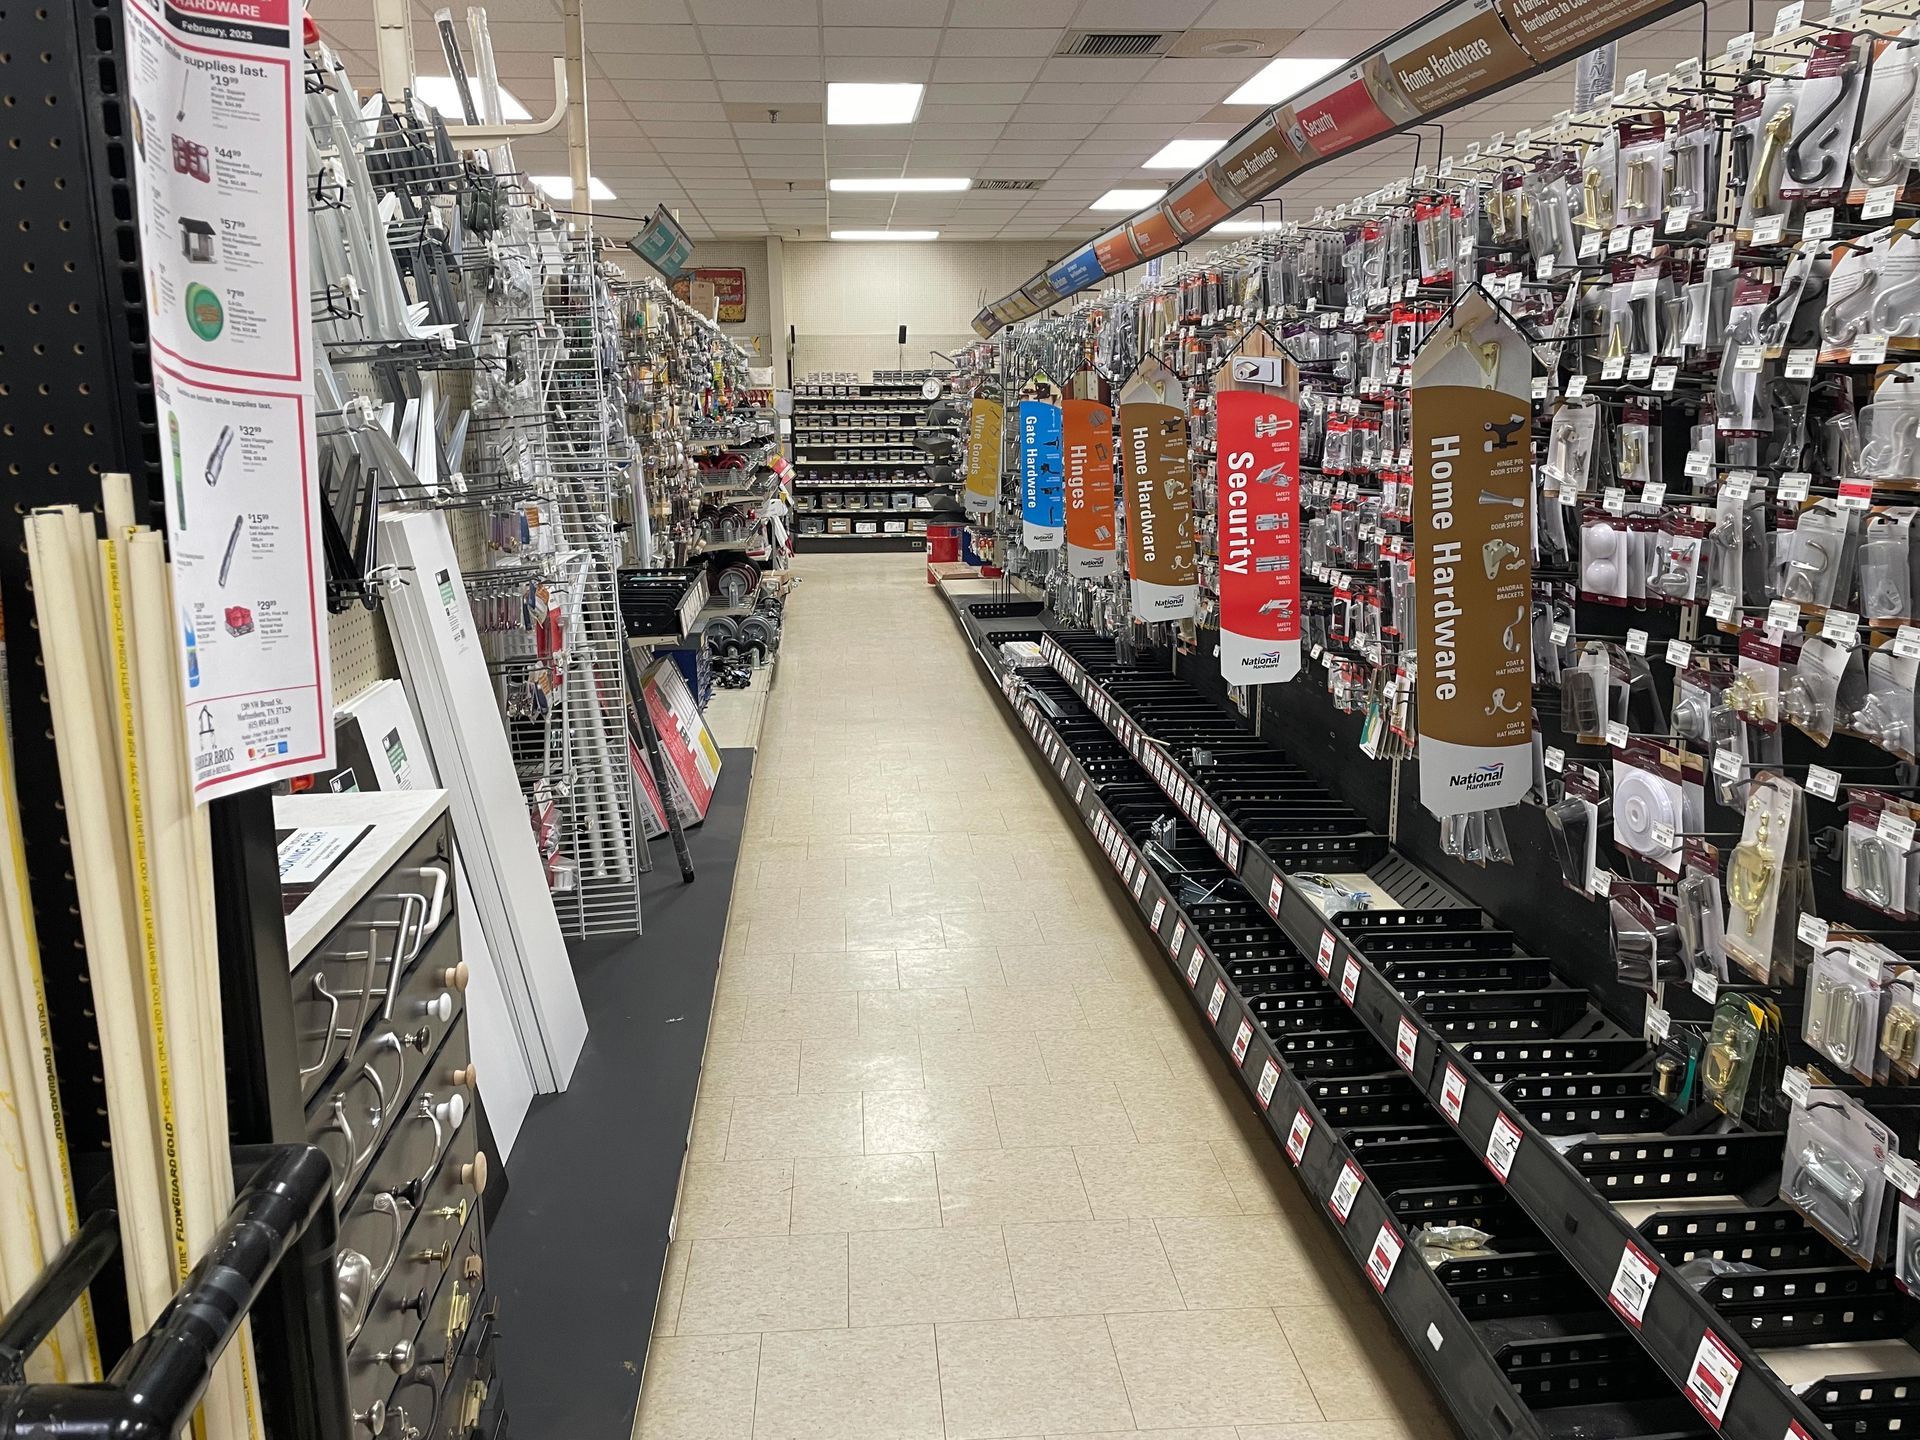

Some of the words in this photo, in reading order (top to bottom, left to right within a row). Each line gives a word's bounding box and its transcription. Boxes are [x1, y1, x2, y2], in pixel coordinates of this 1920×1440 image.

[1521, 7, 1562, 33] Hardware
[1561, 4, 1571, 15] to
[182, 20, 228, 38] February,
[229, 29, 254, 40] 2025
[184, 57, 236, 74] supplies
[240, 64, 268, 78] last.
[1399, 64, 1434, 92] Home
[1430, 36, 1492, 78] Hardware
[1303, 111, 1338, 138] Security
[1227, 168, 1249, 186] Home
[1243, 145, 1279, 175] Hardware
[232, 399, 257, 409] supplies
[258, 401, 272, 410] last.
[975, 413, 986, 440] Wire
[1025, 416, 1037, 445] Gate
[970, 443, 983, 475] Goods
[1132, 427, 1149, 475] Home
[1027, 448, 1038, 509] Hardware
[1068, 445, 1087, 510] Hinges
[1490, 468, 1505, 476] DOOR
[1507, 466, 1524, 475] STOPS
[1431, 435, 1461, 530] Home
[1137, 481, 1156, 562] Hardware
[1223, 451, 1255, 575] Security
[1504, 512, 1524, 520] SPRING
[1490, 523, 1505, 531] DOOR
[1506, 520, 1524, 529] STOPS
[1080, 557, 1104, 567] National
[1496, 591, 1524, 600] BRACKETS
[1497, 584, 1524, 593] HANDRAIL
[1154, 595, 1185, 608] National
[1433, 541, 1463, 700] Hardware
[1242, 653, 1280, 667] National
[1506, 667, 1524, 675] HOOKS
[1507, 729, 1525, 737] HOOKS
[214, 746, 234, 764] BROS
[1450, 766, 1504, 787] National
[1466, 780, 1501, 791] Hardware
